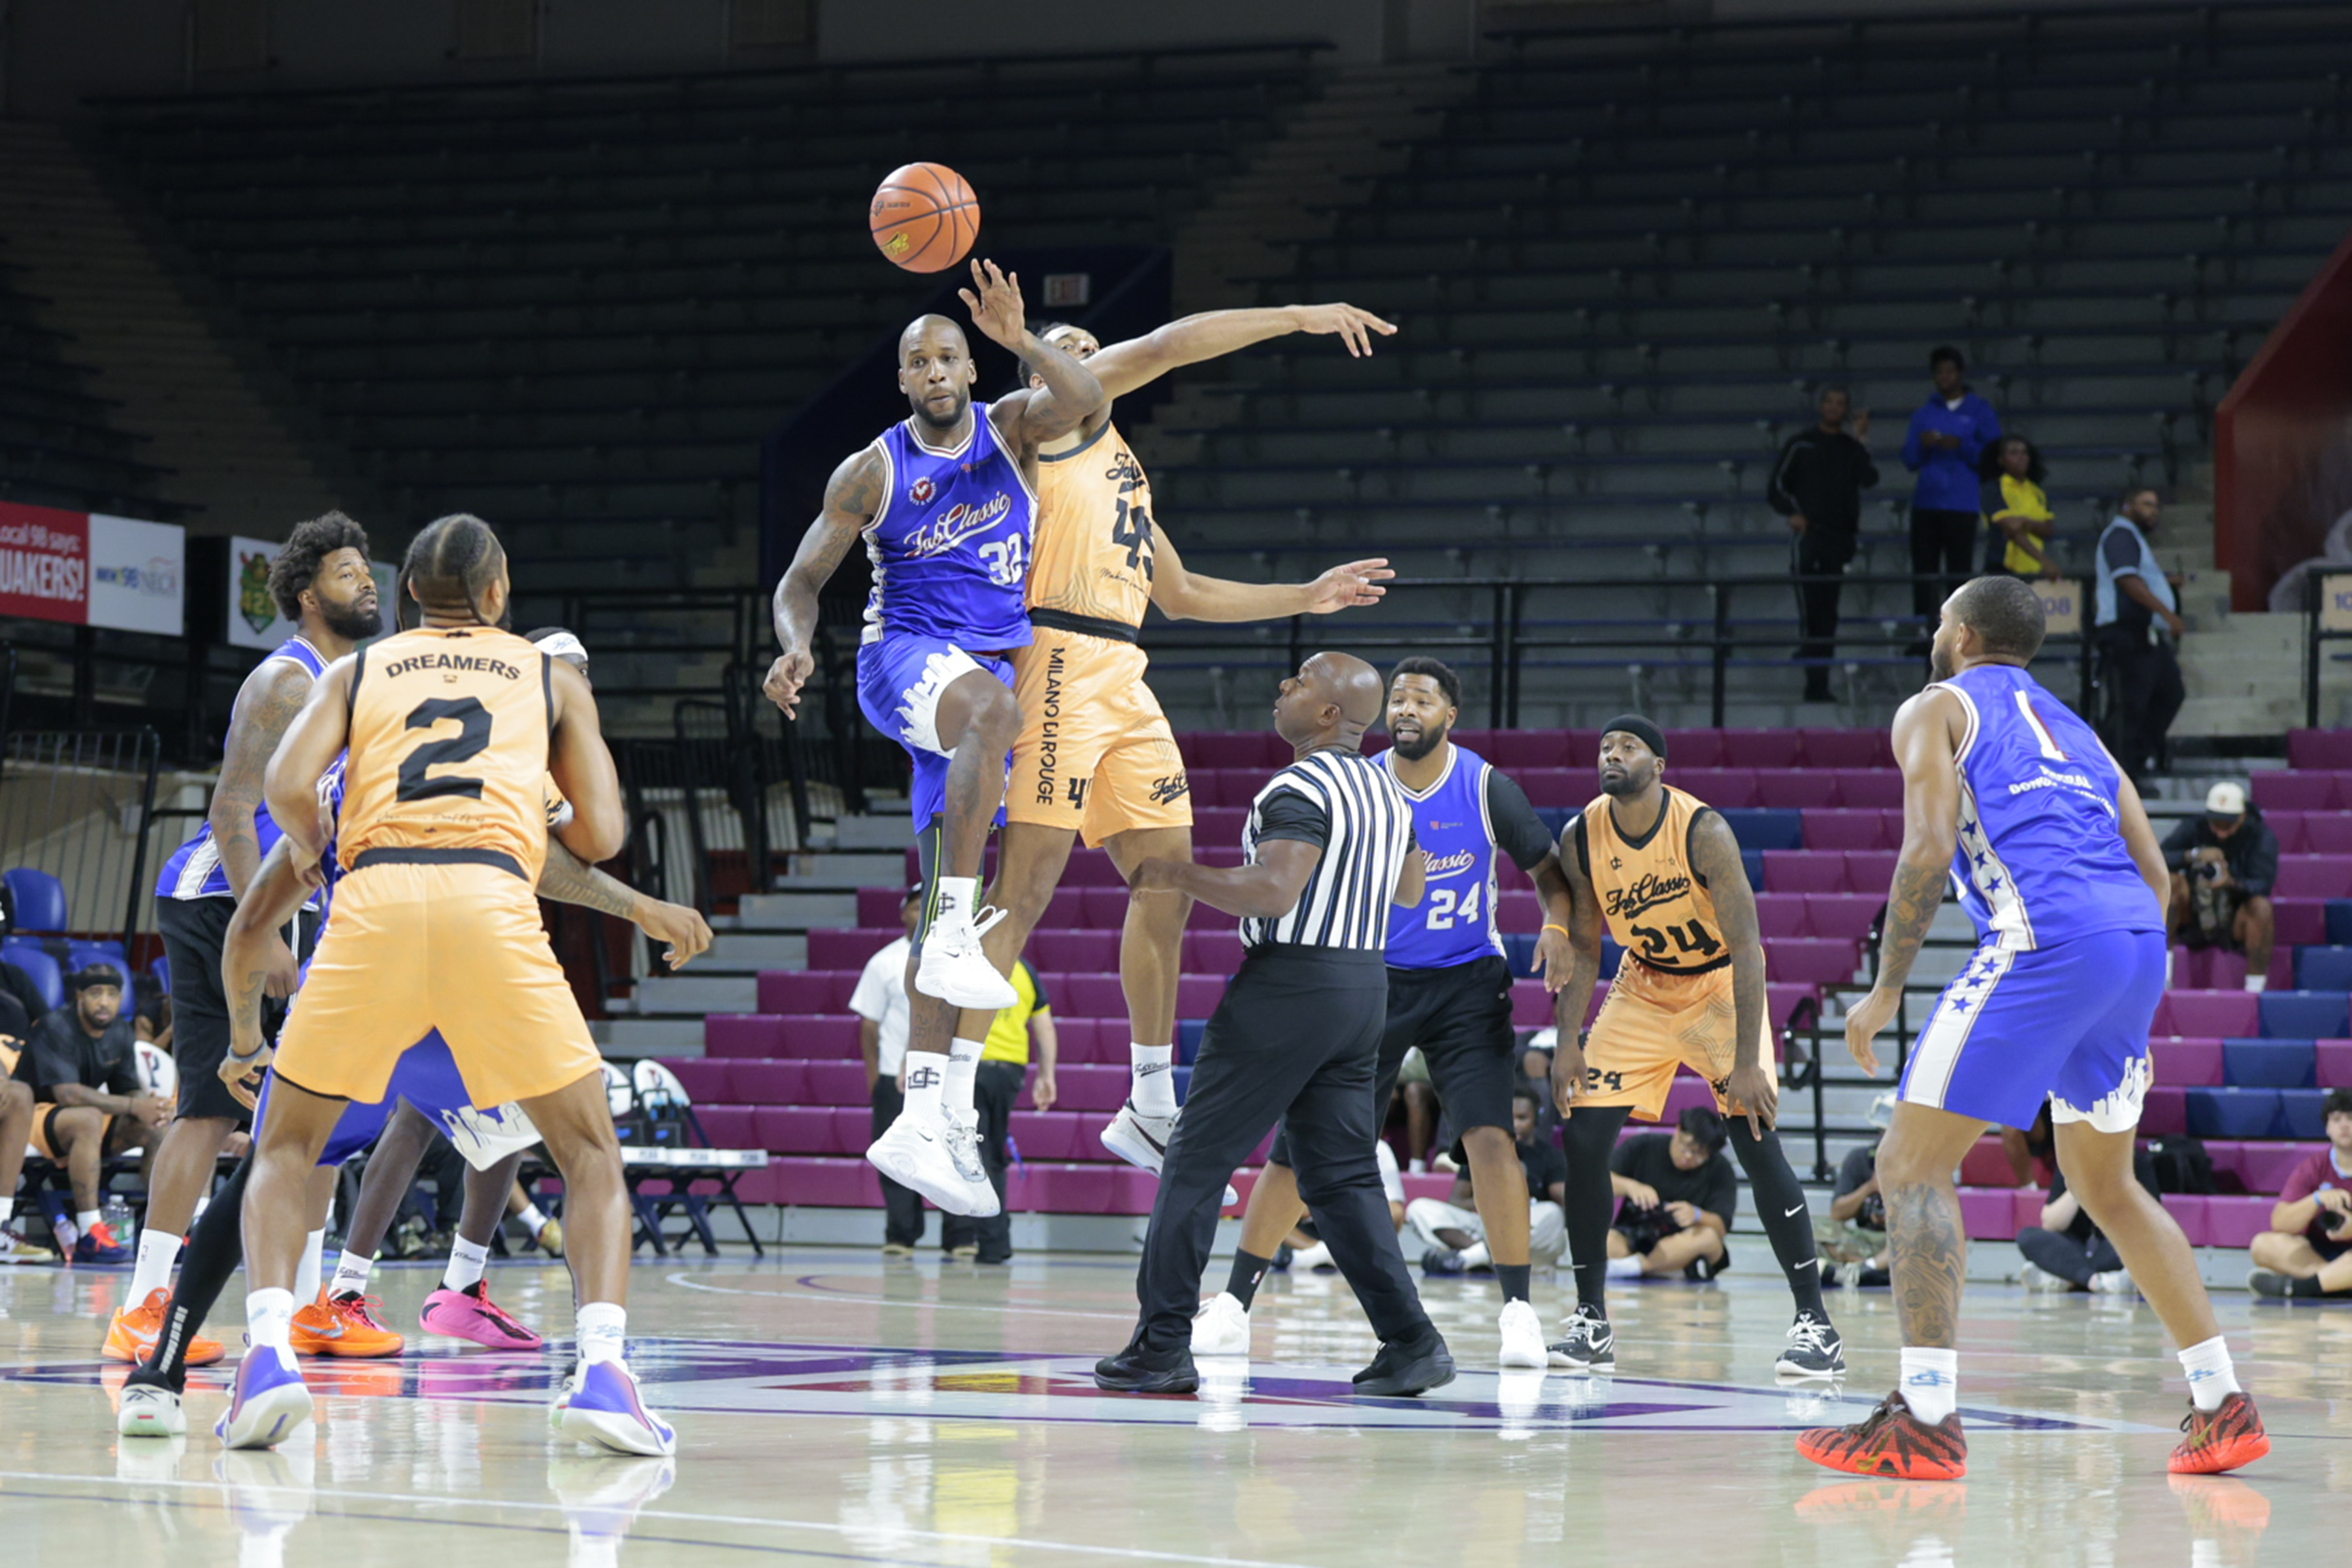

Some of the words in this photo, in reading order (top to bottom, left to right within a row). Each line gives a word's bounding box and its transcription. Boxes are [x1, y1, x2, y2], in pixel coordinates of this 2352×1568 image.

[0, 523, 28, 546] ocal
[978, 532, 1024, 586] 32
[2038, 596, 2072, 616] 08
[385, 654, 521, 681] DREAMERS
[1044, 647, 1065, 717] MILANO
[396, 696, 493, 803] 2
[1043, 722, 1059, 737] DI
[2014, 690, 2070, 762] 1
[1036, 741, 1057, 806] ROUGE
[1426, 881, 1482, 930] 24
[1630, 919, 1722, 964] 24
[1588, 1067, 1624, 1091] 24
